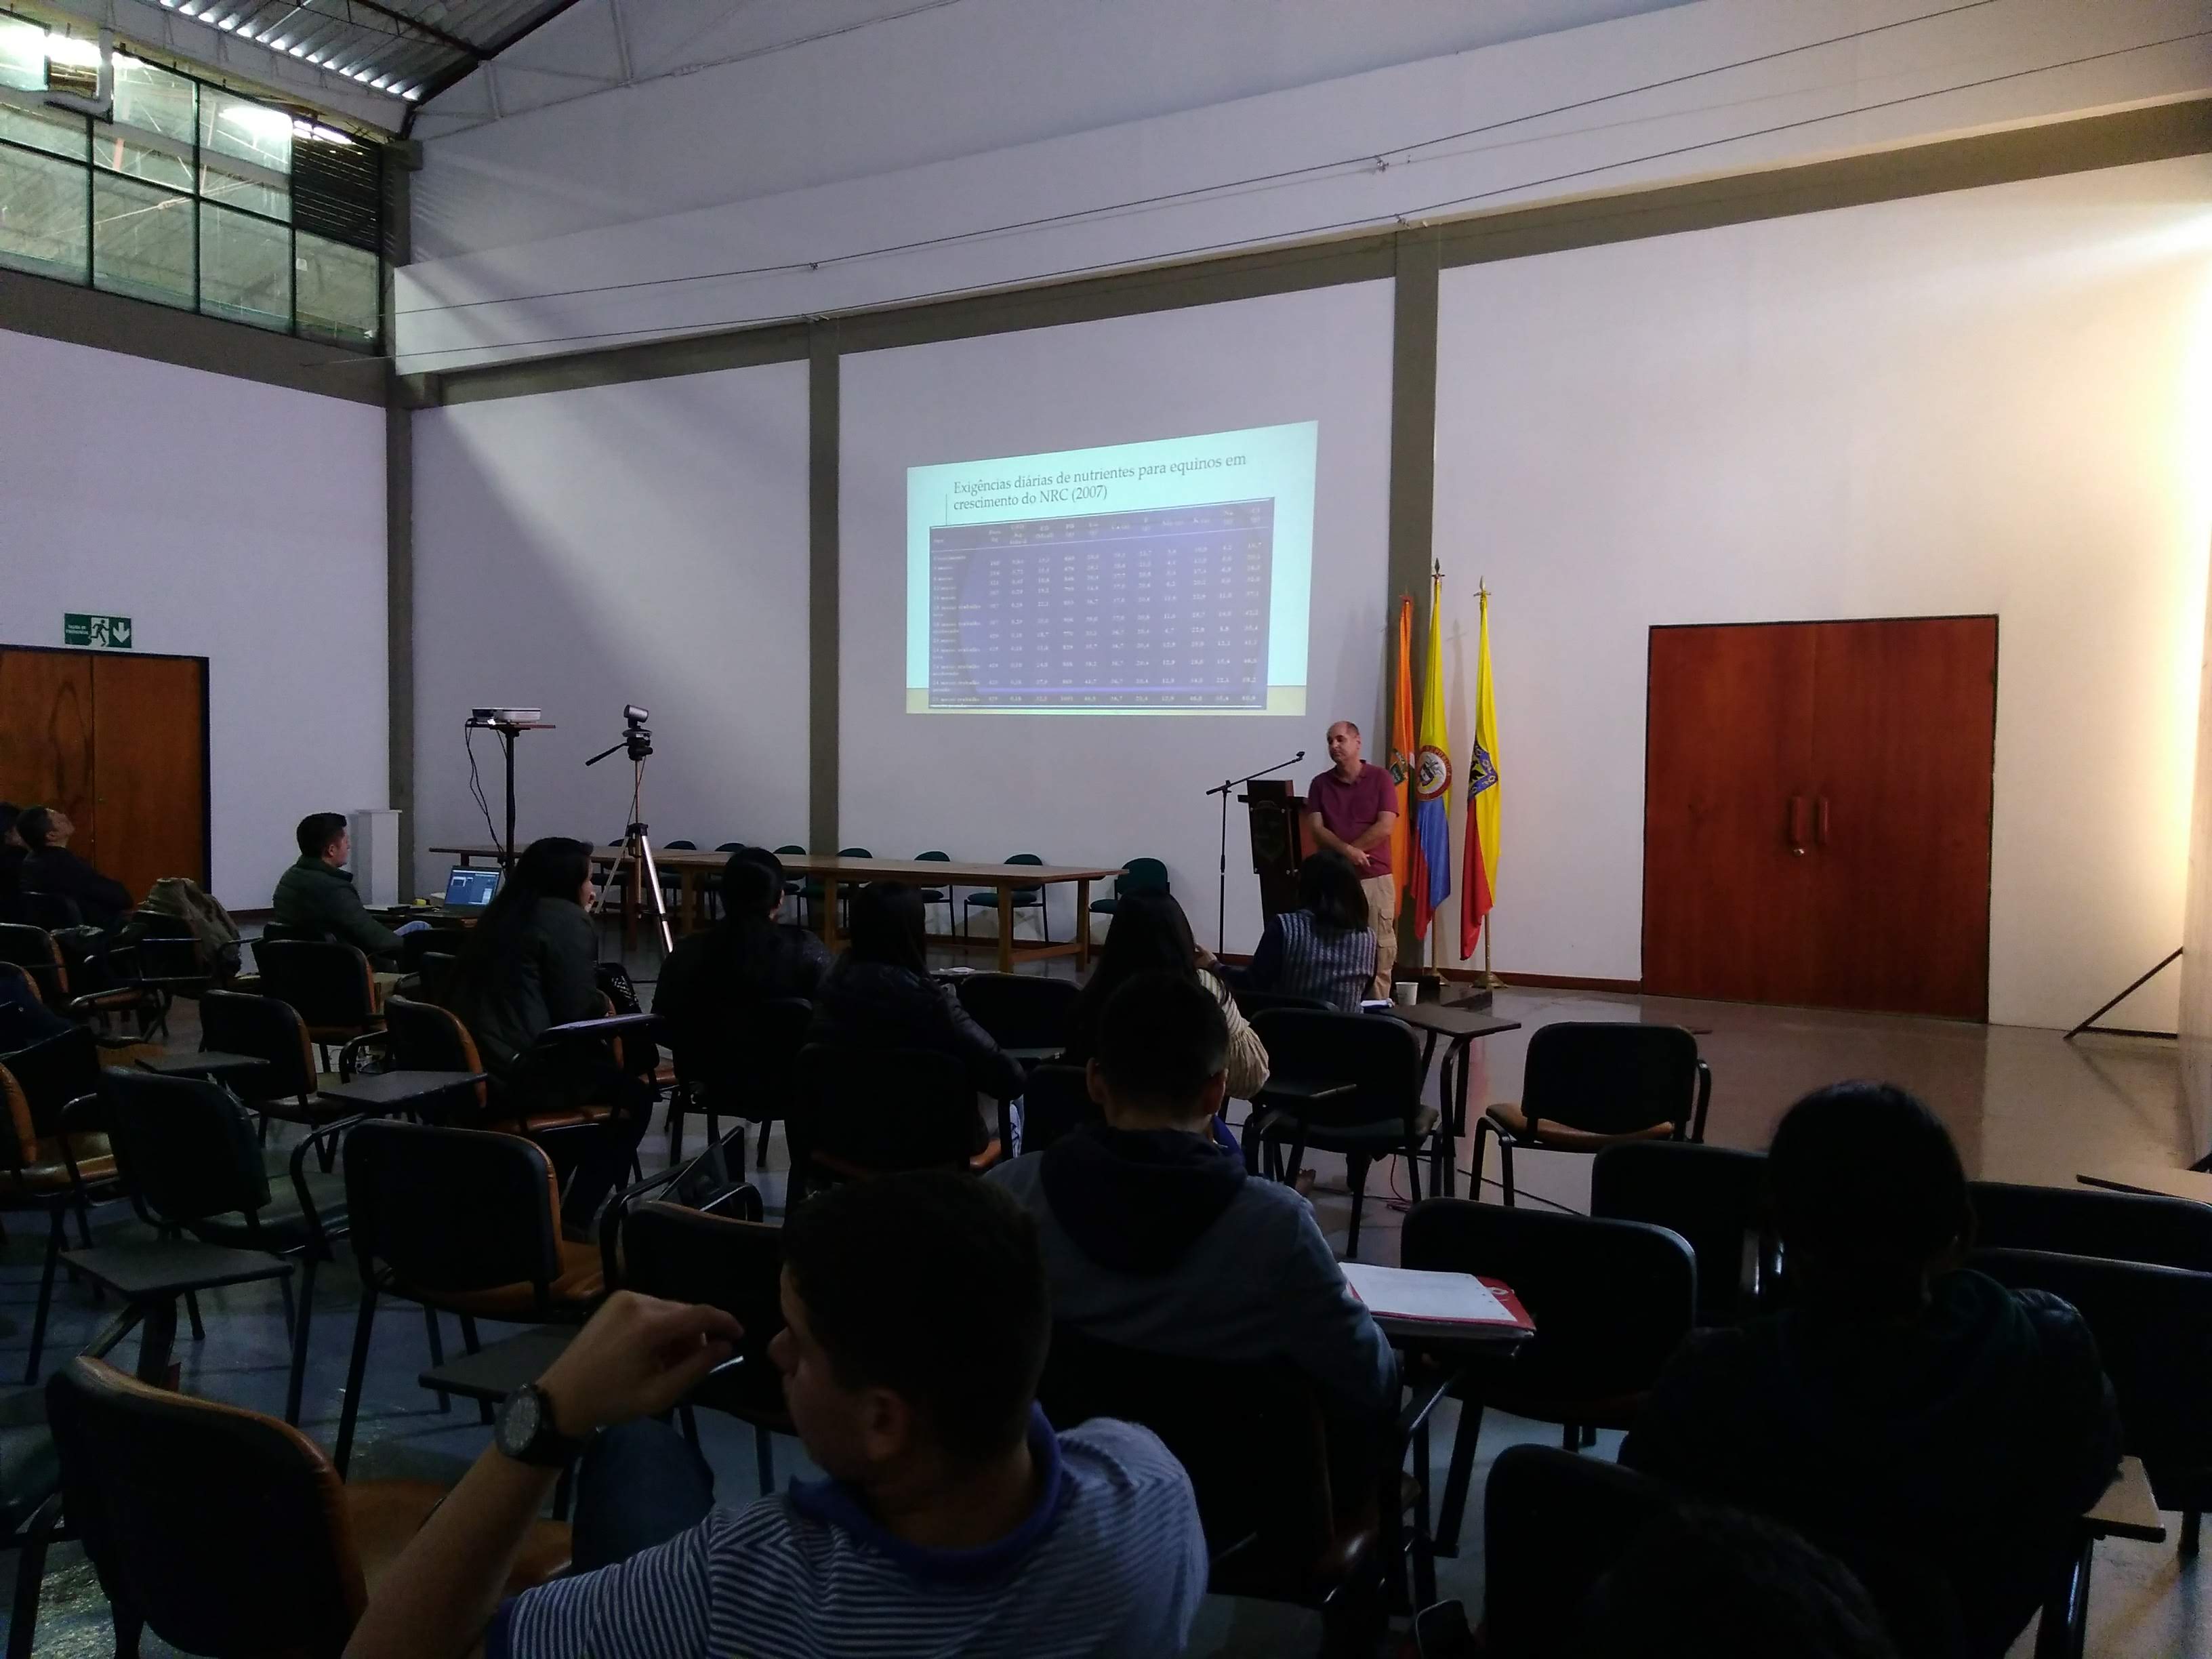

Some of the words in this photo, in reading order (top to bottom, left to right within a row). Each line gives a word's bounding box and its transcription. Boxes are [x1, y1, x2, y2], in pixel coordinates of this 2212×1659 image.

[954, 479, 1011, 496] Exigências
[1014, 476, 1052, 489] diárias
[1057, 472, 1071, 483] de
[1073, 466, 1134, 483] nutrientes
[1138, 465, 1166, 480] para
[1170, 457, 1221, 475] equinos
[1225, 455, 1246, 466] em
[954, 495, 1019, 510] crescimento
[1021, 492, 1036, 504] do
[1040, 488, 1069, 503] NRC
[1071, 485, 1107, 503] (2007)
